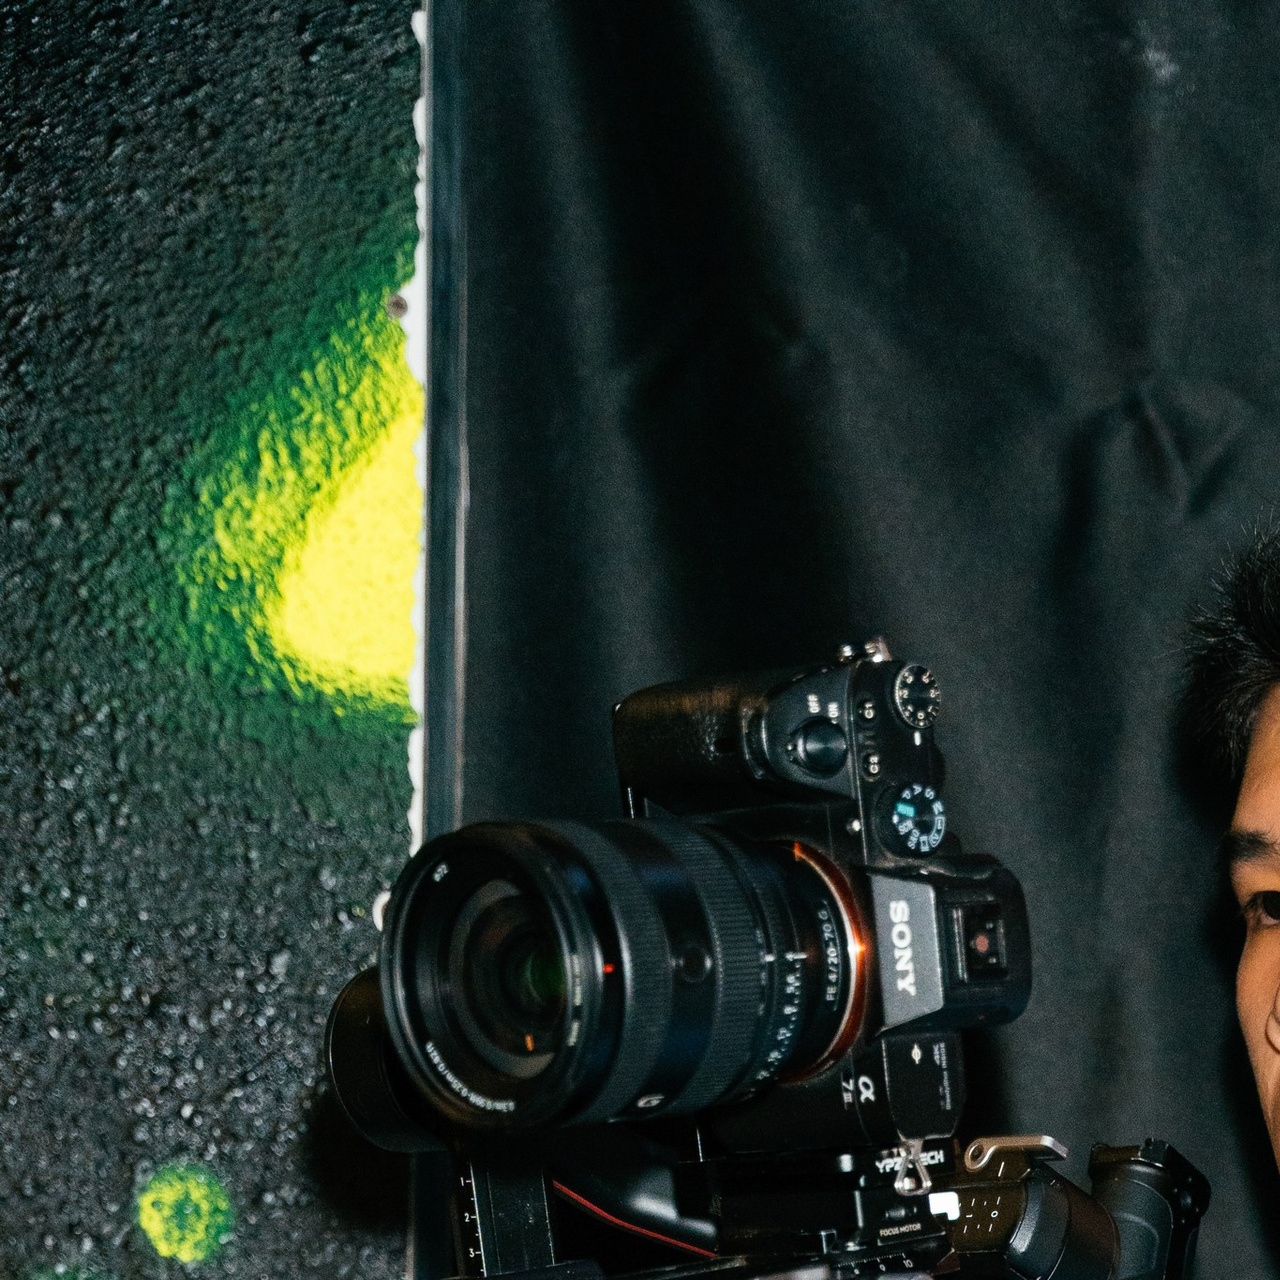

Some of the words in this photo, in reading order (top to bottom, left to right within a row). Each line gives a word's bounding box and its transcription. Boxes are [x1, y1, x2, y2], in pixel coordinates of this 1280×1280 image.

[807, 694, 820, 714] OFF
[828, 701, 839, 718] ON
[864, 702, 874, 719] C1
[869, 755, 879, 774] C2
[818, 909, 828, 920] G
[889, 900, 917, 997] SONY
[826, 986, 835, 1001] FE
[464, 1213, 470, 1223] 2
[880, 1226, 900, 1237] FOCUS
[900, 1222, 921, 1233] MOTOR
[468, 1248, 475, 1258] 3
[903, 1259, 914, 1269] 10
